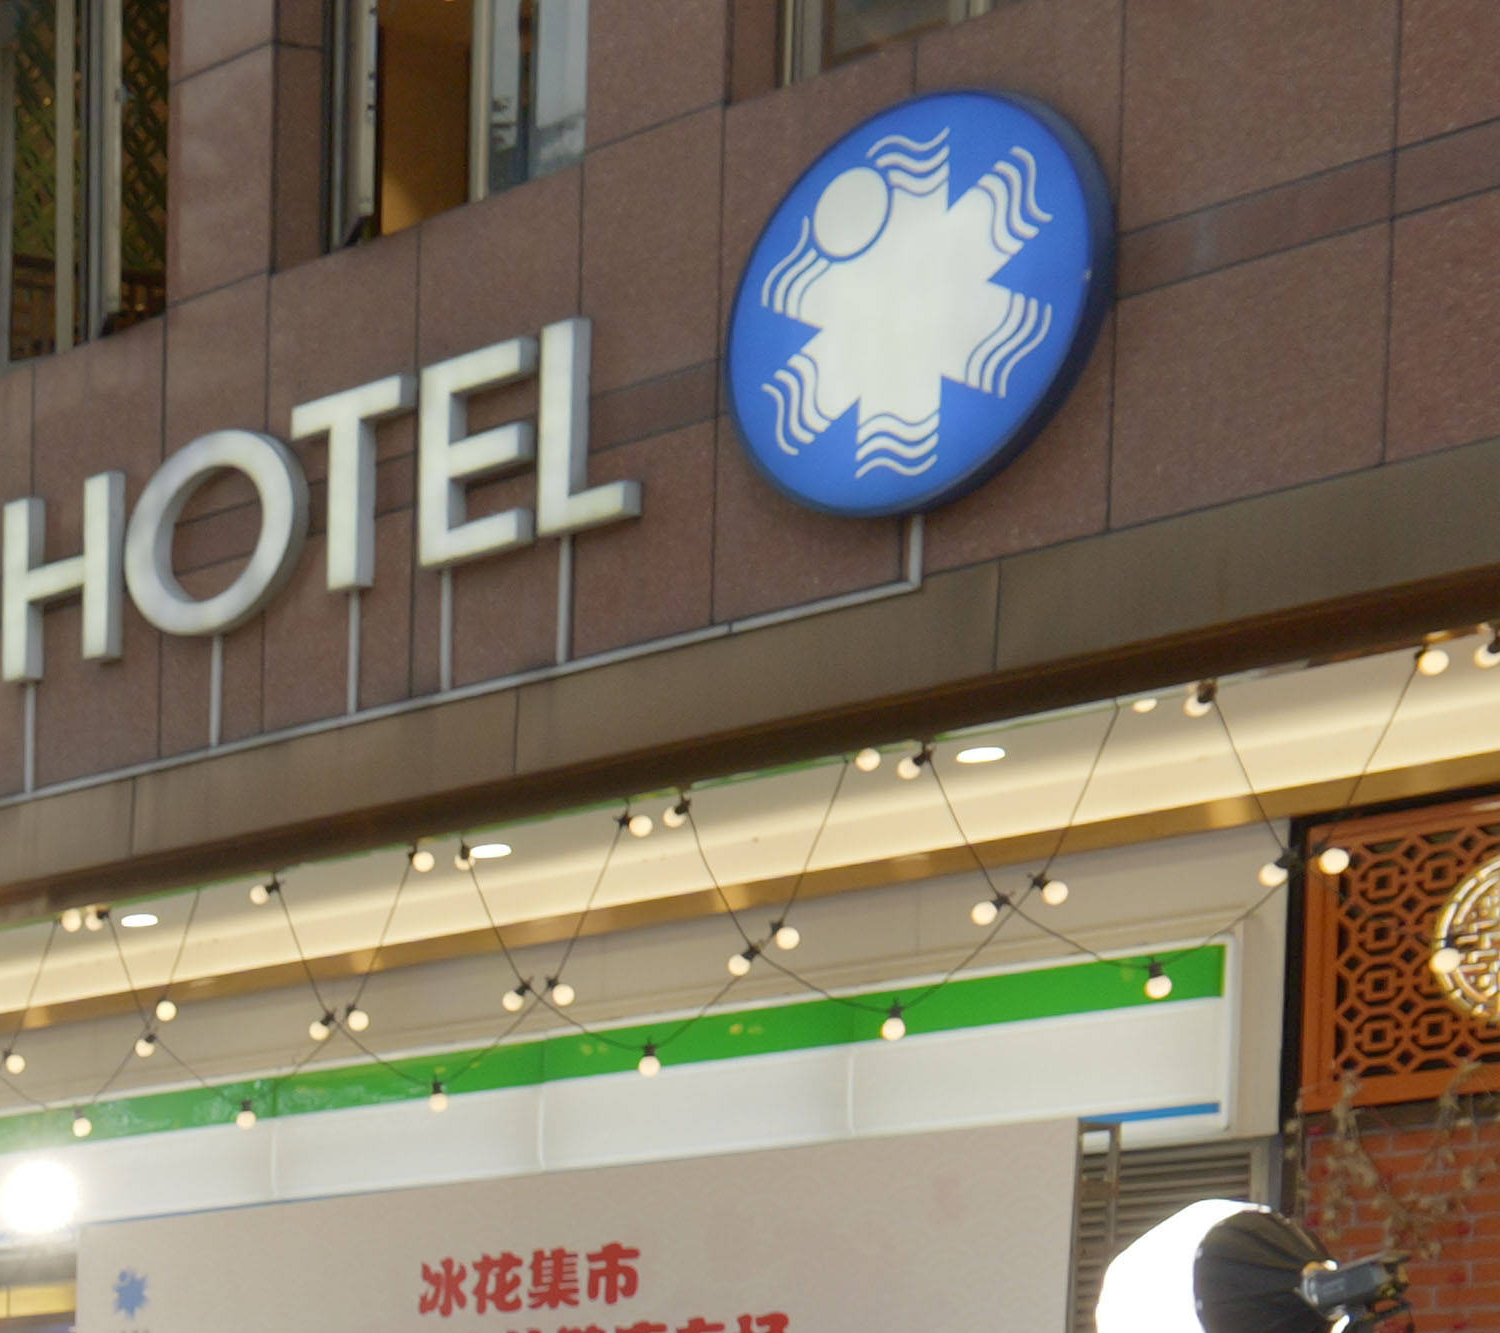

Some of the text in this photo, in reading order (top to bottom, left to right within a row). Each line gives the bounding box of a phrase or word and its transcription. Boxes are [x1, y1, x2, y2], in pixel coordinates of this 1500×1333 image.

[1, 316, 644, 684] HOTEL
[418, 1242, 641, 1318] 冰花集市
